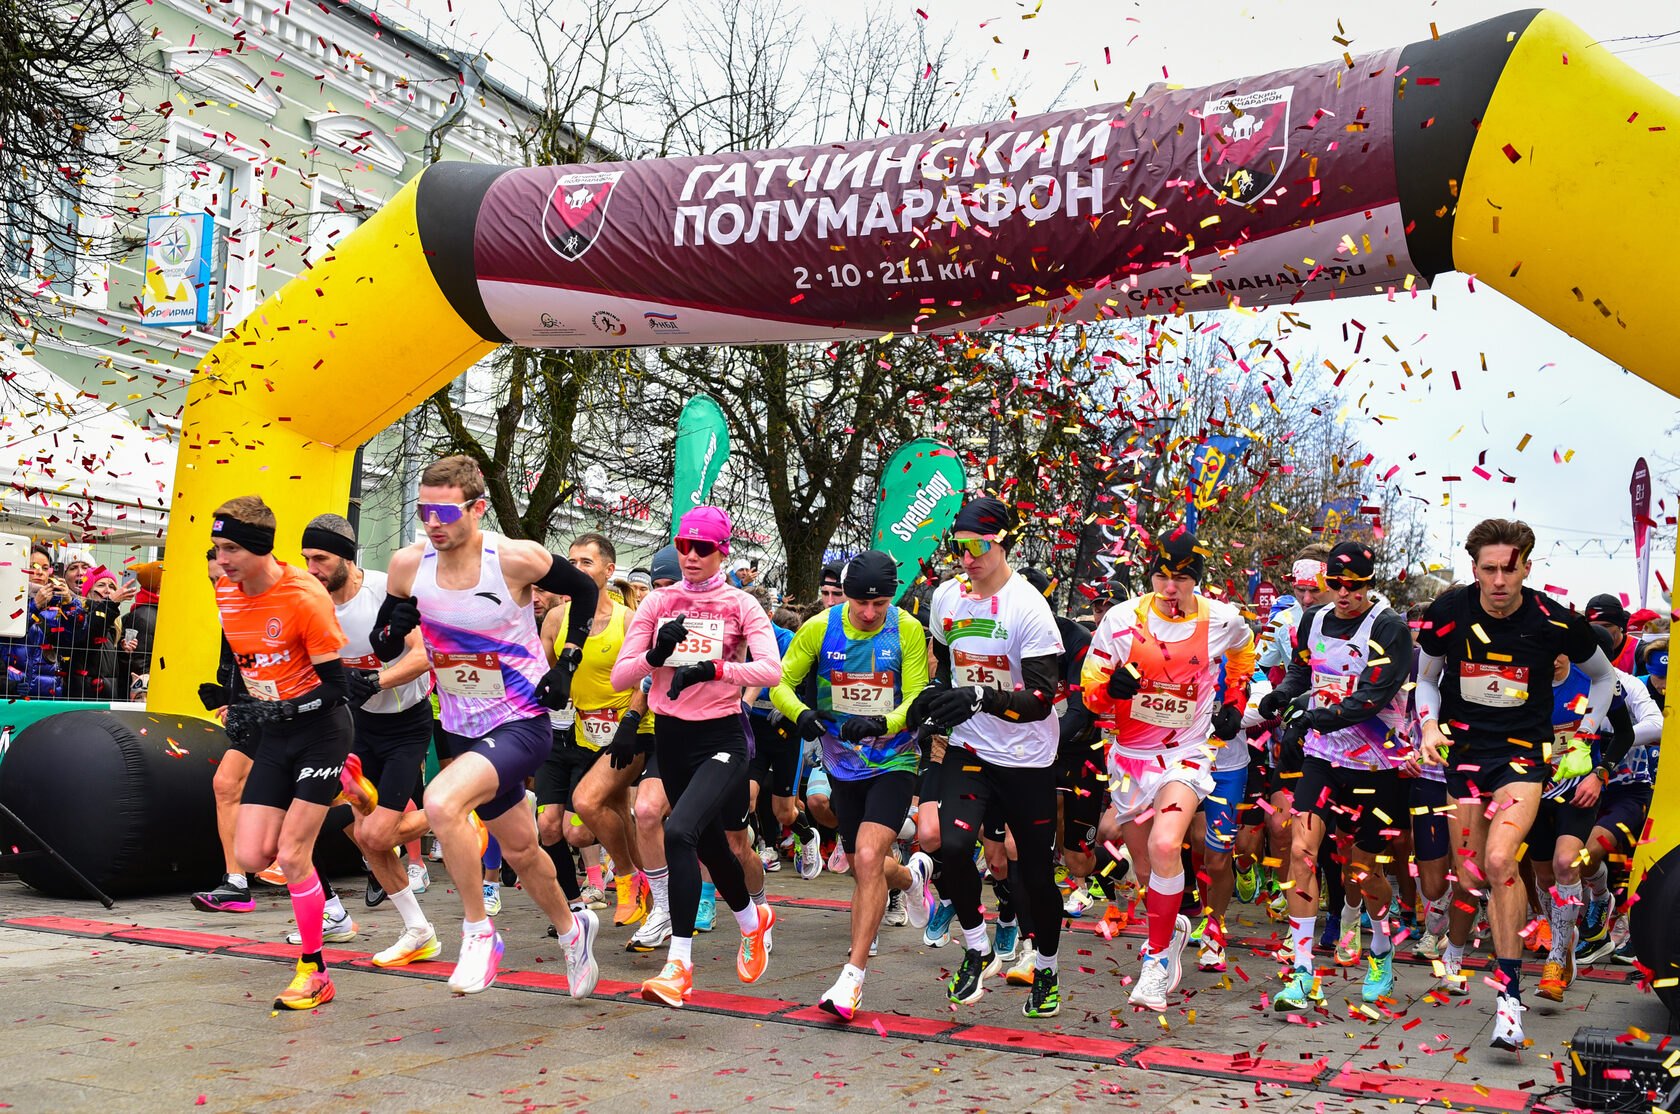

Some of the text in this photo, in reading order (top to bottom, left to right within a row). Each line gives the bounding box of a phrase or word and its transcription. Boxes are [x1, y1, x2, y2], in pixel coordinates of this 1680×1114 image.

[679, 112, 1110, 201] ГАТЧИНСКИЙ
[673, 167, 1104, 247] ПОЛУМАРАФОН
[890, 469, 952, 542] SvetoCopy
[455, 669, 480, 683] 24
[841, 687, 883, 701] 1527
[1486, 680, 1500, 693] 4
[1140, 694, 1188, 713] 2645
